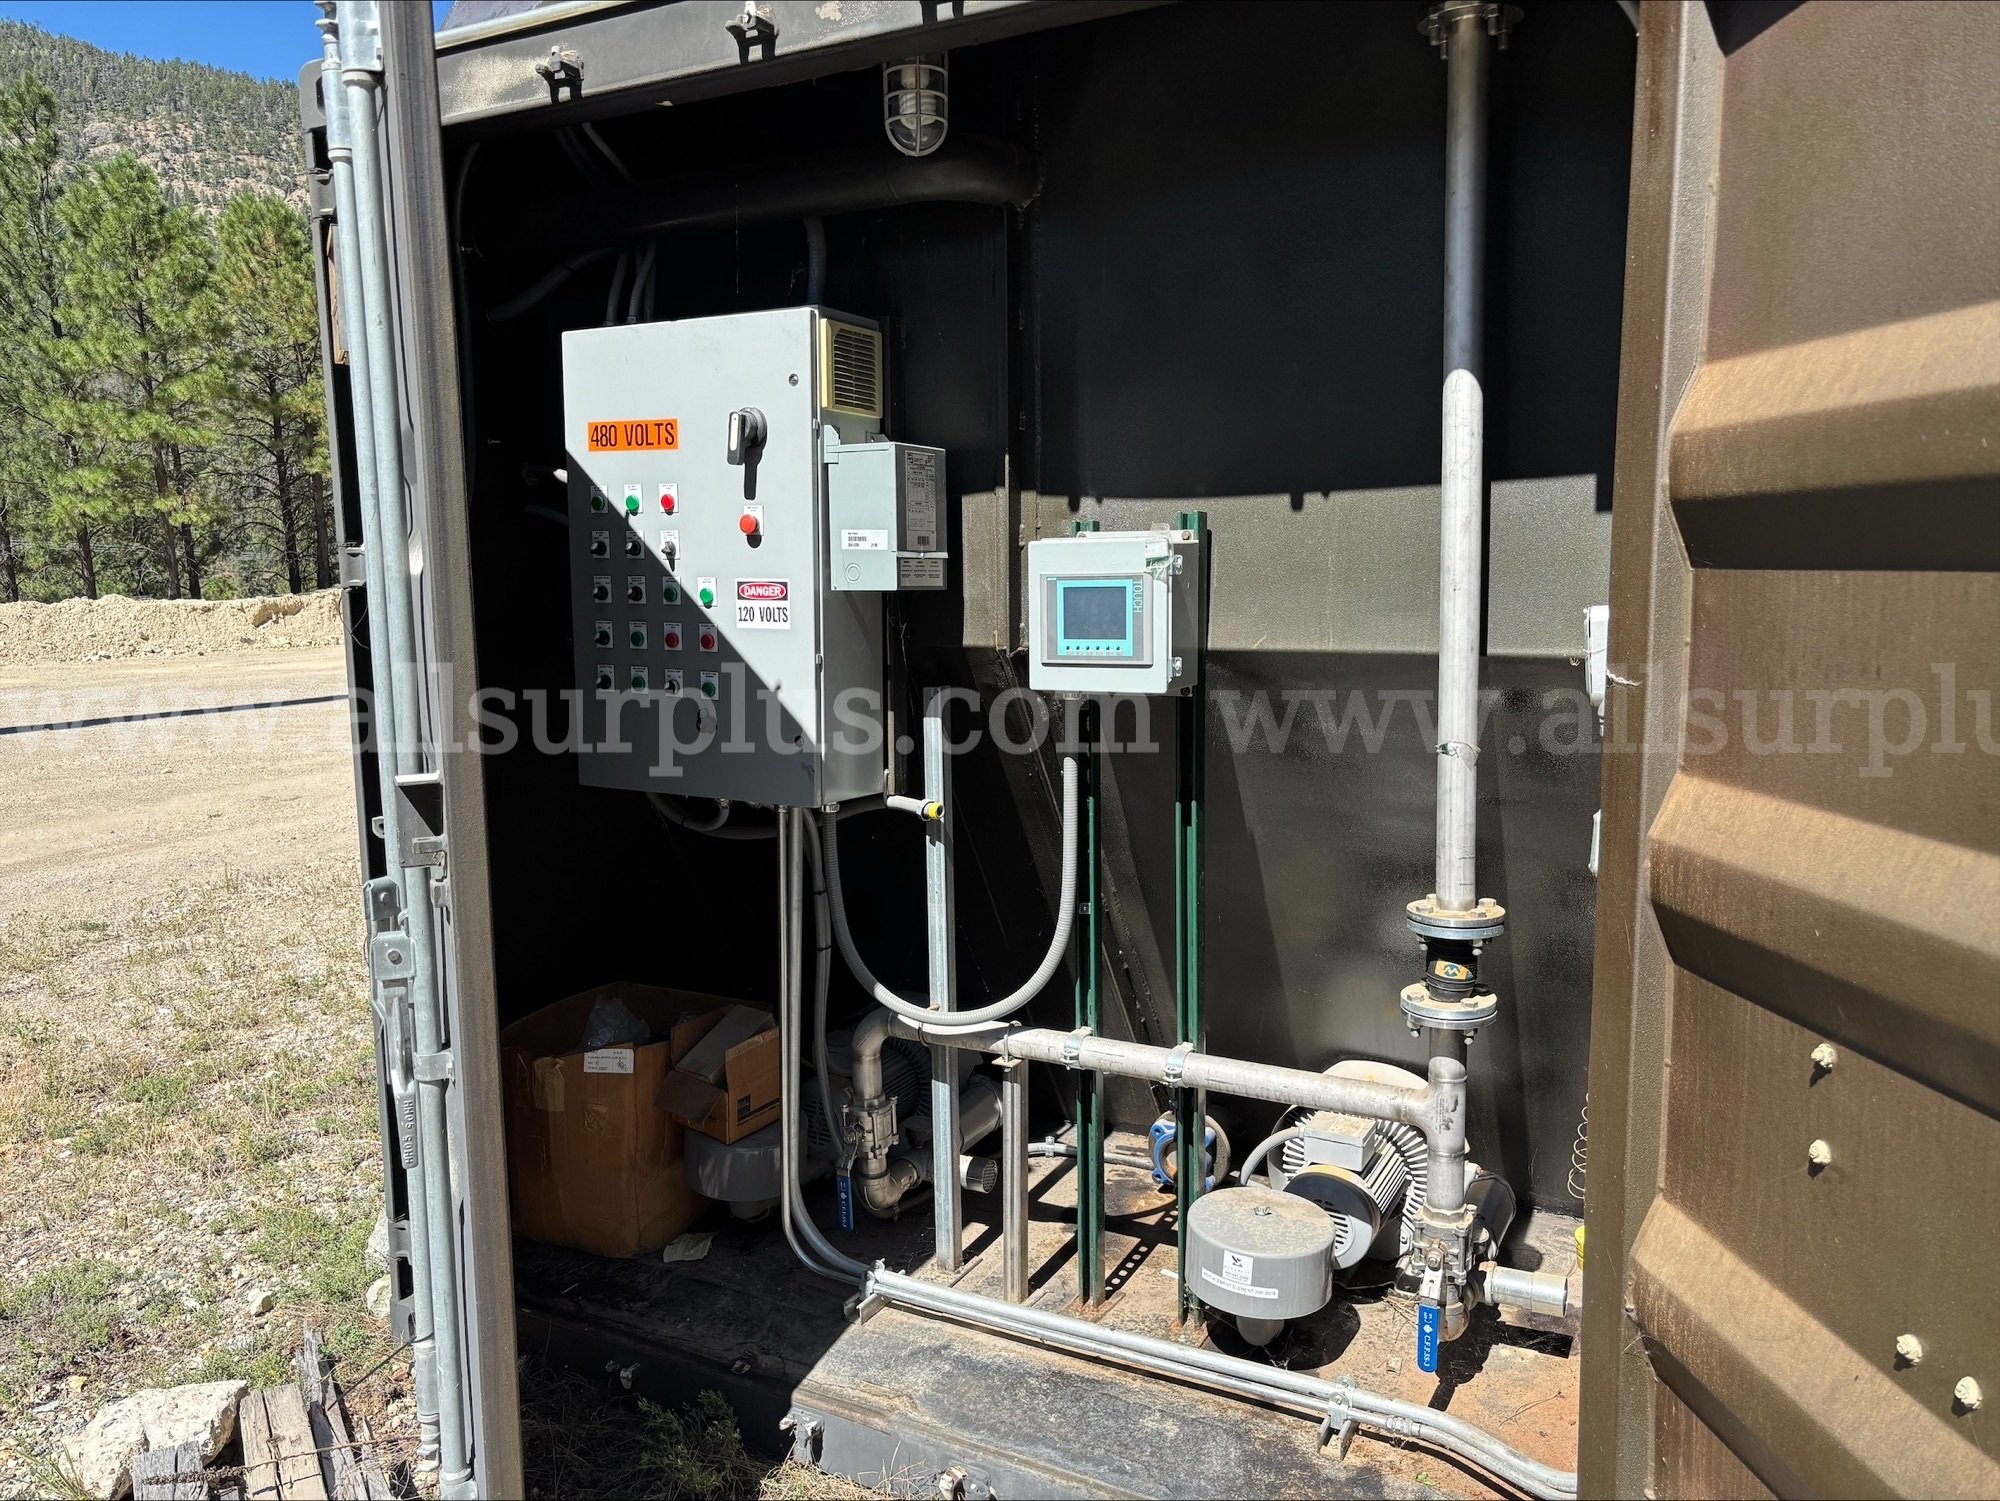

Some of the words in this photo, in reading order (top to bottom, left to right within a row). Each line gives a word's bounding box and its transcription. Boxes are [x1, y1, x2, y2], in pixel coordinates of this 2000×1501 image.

[591, 424, 618, 447] 480
[624, 422, 675, 446] VOLTS
[744, 586, 782, 597] DANGER
[1133, 579, 1143, 613] TOUCH
[738, 606, 755, 622] 120
[759, 606, 789, 623] VOLTS
[1232, 1284, 1254, 1294] ELEMENT
